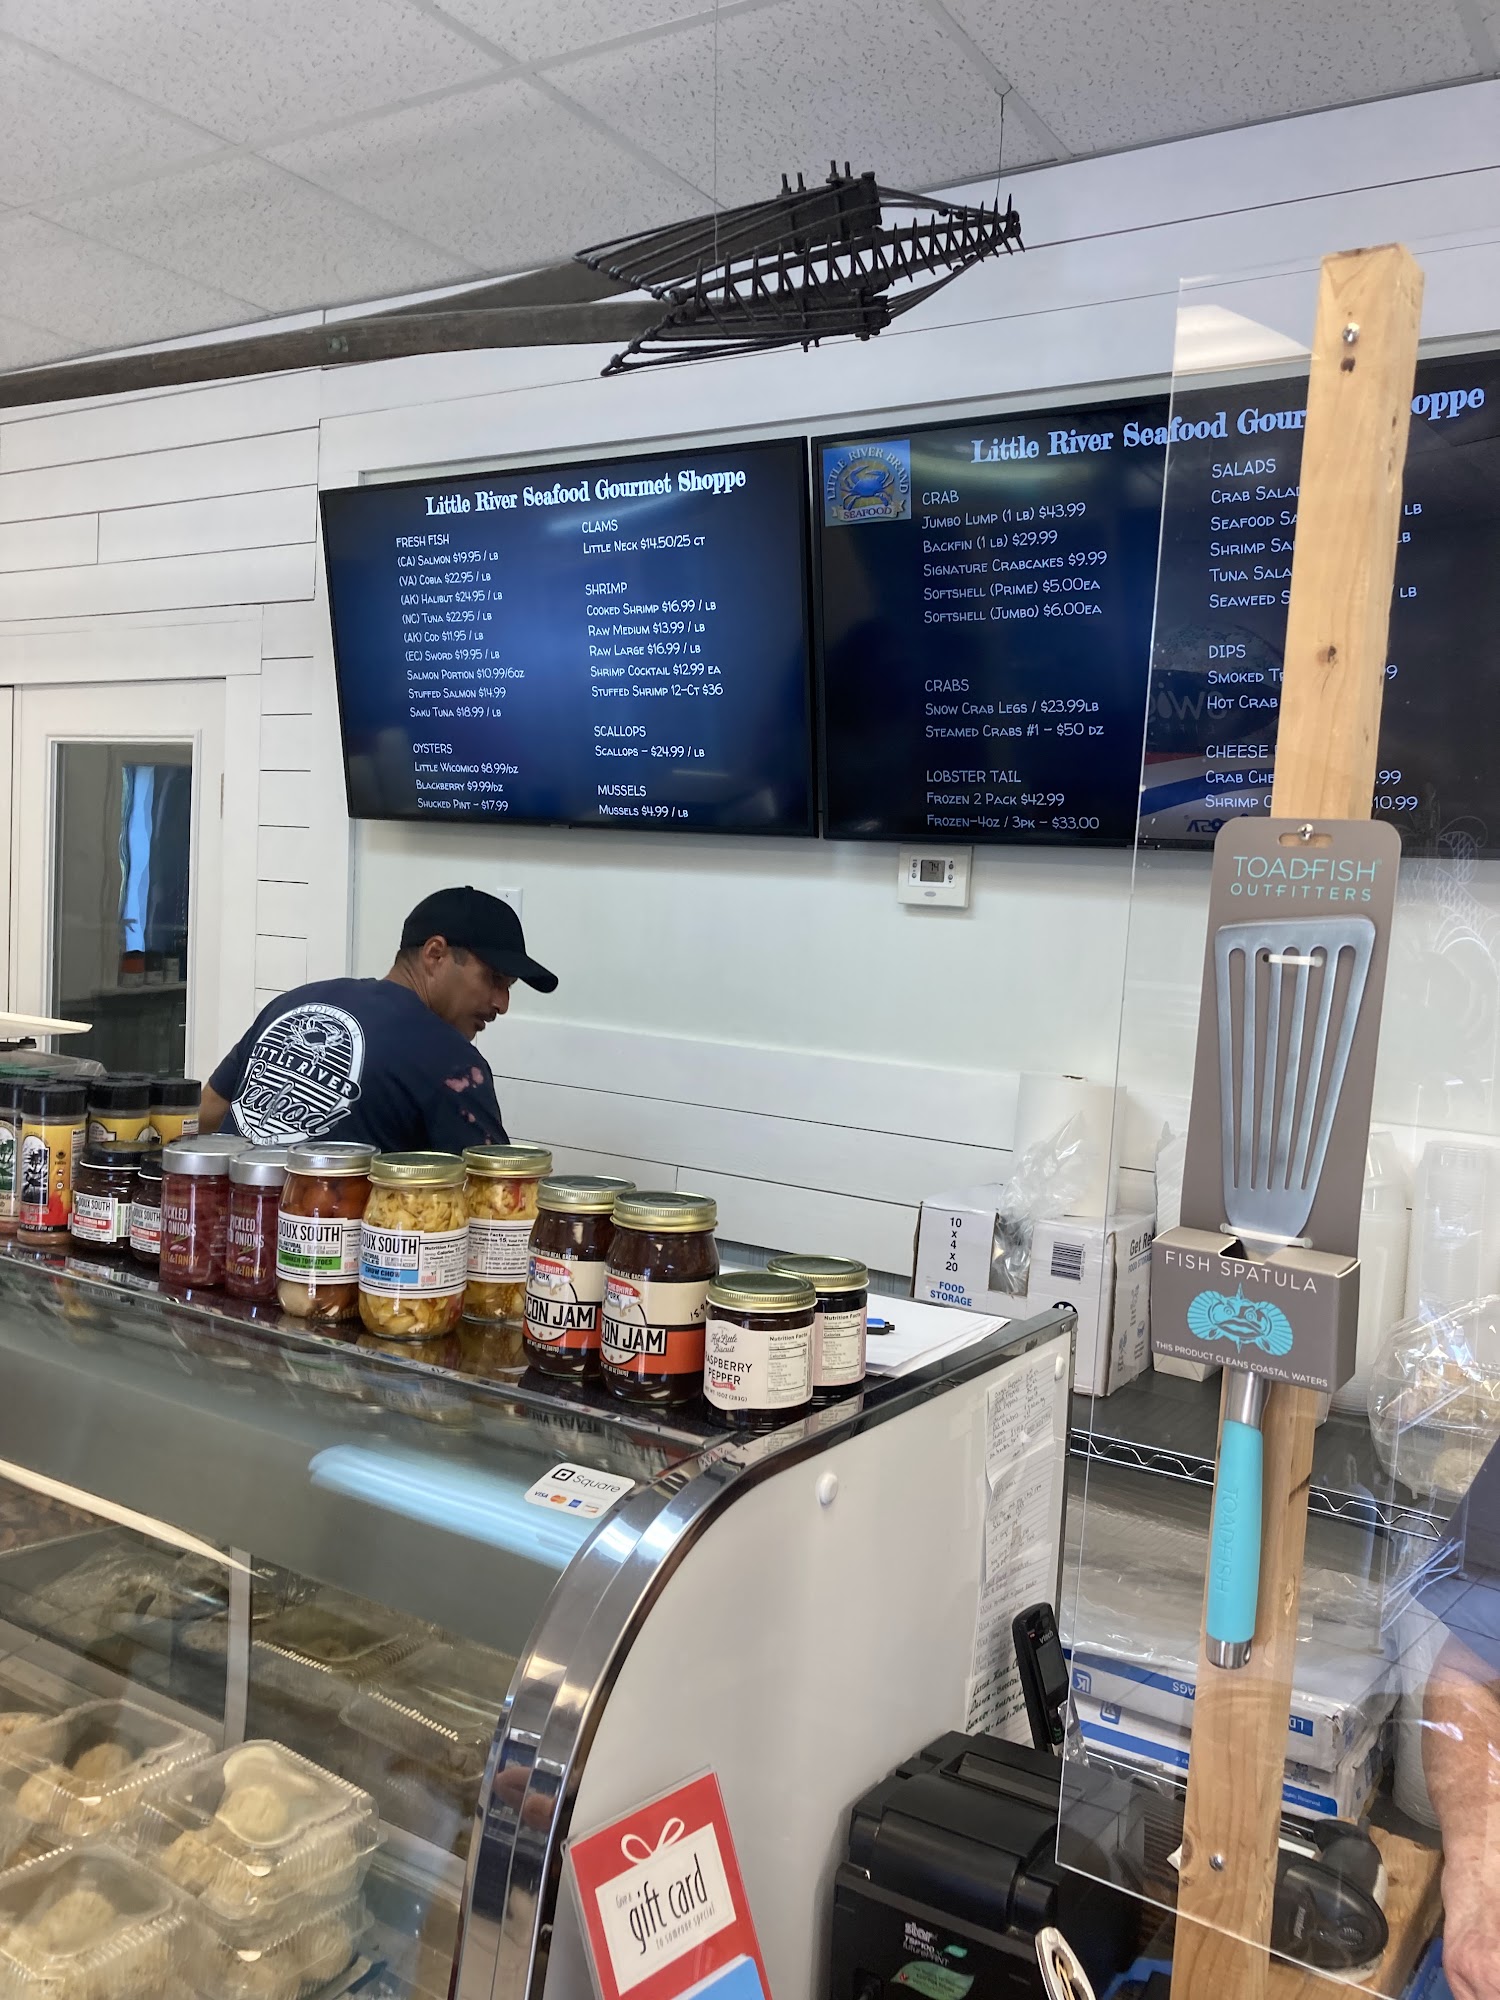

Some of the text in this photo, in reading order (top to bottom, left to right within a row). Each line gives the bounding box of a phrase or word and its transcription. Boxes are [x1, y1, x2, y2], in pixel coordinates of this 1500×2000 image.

[968, 435, 1039, 468] Little
[1046, 429, 1114, 456] River
[1123, 412, 1228, 447] Seafood
[1236, 407, 1305, 435] Gour
[827, 447, 909, 500] LITTLE RIVER BRAND
[1211, 458, 1276, 478] SALADS
[424, 470, 746, 515] Little River Seafood Gourmet Shoppe
[922, 489, 959, 505] CRAB
[843, 507, 892, 520] SEAFOOD
[581, 518, 618, 533] CLAMS
[395, 533, 449, 548] FRESH FISH
[1253, 565, 1292, 583] SALA
[585, 581, 627, 596] SHRIMP
[1208, 643, 1246, 658] DIPS
[924, 678, 969, 692] CRABS
[593, 725, 646, 737] SCALLOPS
[412, 742, 452, 754] OYSTERS
[1204, 744, 1268, 761] CHEESE
[926, 769, 1021, 783] LOBSTER TAIL
[597, 784, 646, 797] MUSSELS
[929, 862, 939, 871] 74
[1233, 856, 1376, 883] TOADFISH
[1230, 883, 1372, 901] OUTFITTERS
[252, 1045, 353, 1096] LITTLE RIVER
[241, 1060, 351, 1137] Seafood
[91, 1199, 111, 1211] SOUTH
[168, 1221, 196, 1236] ONIONS
[950, 1217, 962, 1228] 10
[235, 1231, 265, 1247] ONIONS
[300, 1226, 340, 1242] SOUTH
[379, 1236, 417, 1254] SOUTH
[950, 1240, 957, 1249] 4
[1129, 1234, 1142, 1256] Get
[535, 1263, 565, 1275] CHESHIRE
[945, 1261, 958, 1272] 20
[1165, 1250, 1318, 1294] FISH SPATULA
[536, 1271, 550, 1281] PORK
[939, 1281, 965, 1294] FOOD
[930, 1289, 972, 1307] STORAGE
[553, 1305, 593, 1328] JAM
[623, 1327, 663, 1353] JAM
[721, 1333, 738, 1344] Little
[713, 1344, 735, 1354] Biscuit
[1155, 1341, 1328, 1388] THIS PRODUCT CLEANS COASTAL WATERS
[708, 1368, 741, 1385] PEPPER
[572, 1474, 621, 1493] Square
[1215, 1487, 1239, 1593] TOADFISH
[629, 1852, 708, 1956] gift card
[656, 1903, 716, 1951] to someone special
[904, 1922, 933, 1943] star
